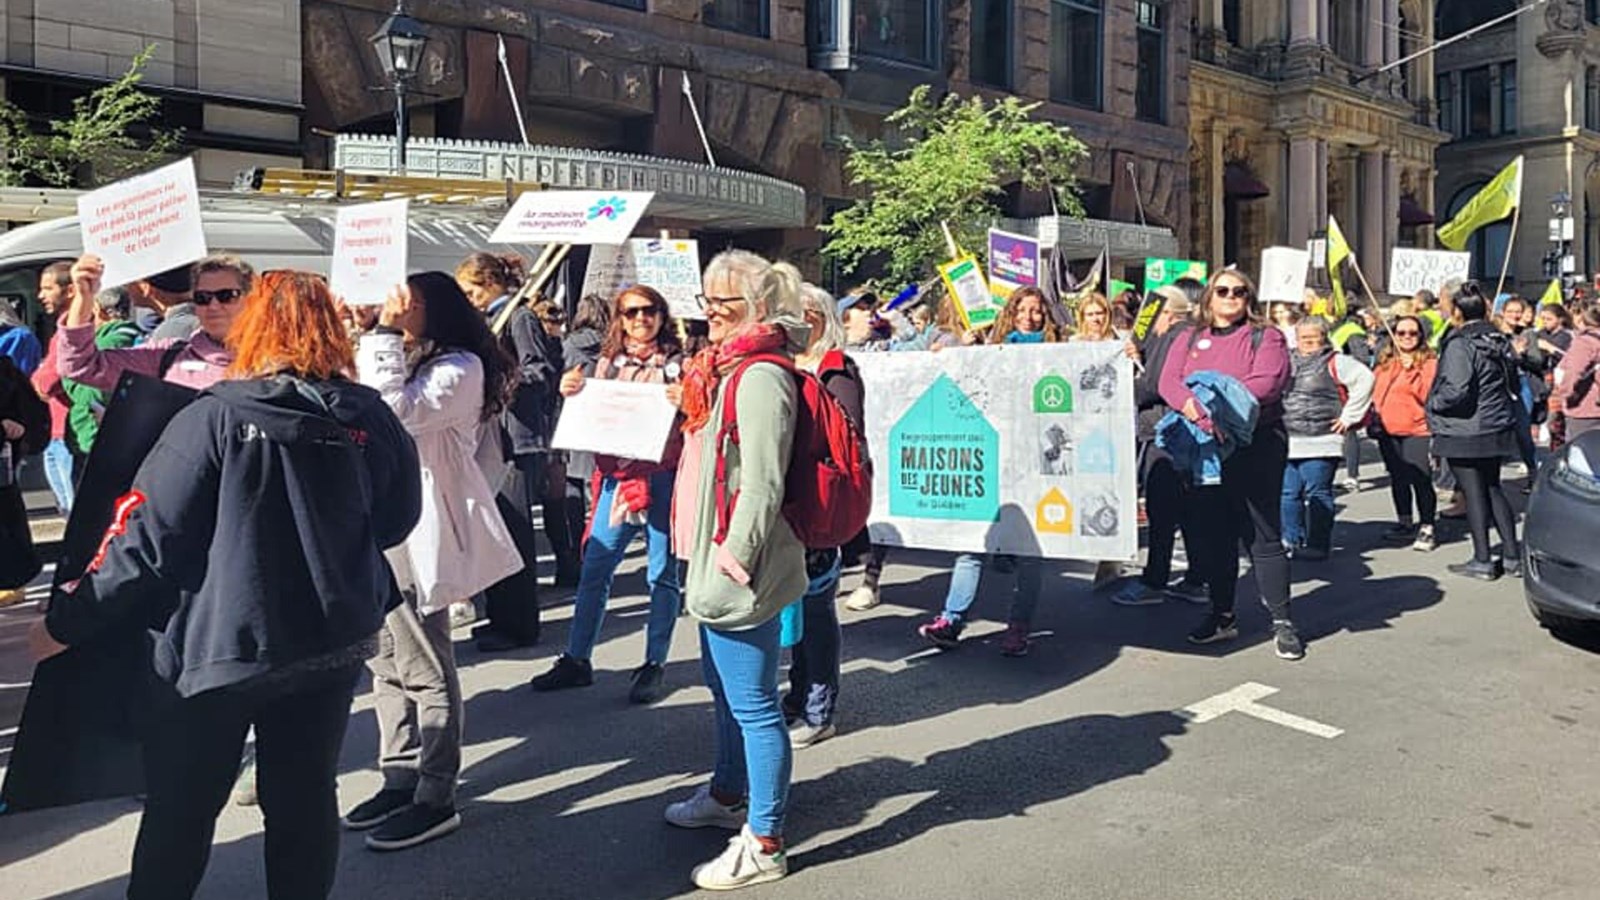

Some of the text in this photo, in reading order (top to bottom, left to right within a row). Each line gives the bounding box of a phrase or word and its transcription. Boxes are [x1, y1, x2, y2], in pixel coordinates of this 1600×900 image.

[138, 204, 157, 219] pour
[538, 210, 585, 219] maison
[517, 218, 587, 229] marguerite
[901, 432, 965, 444] Regroupement
[901, 446, 984, 472] MAISONS
[901, 472, 985, 498] DES JEUNES
